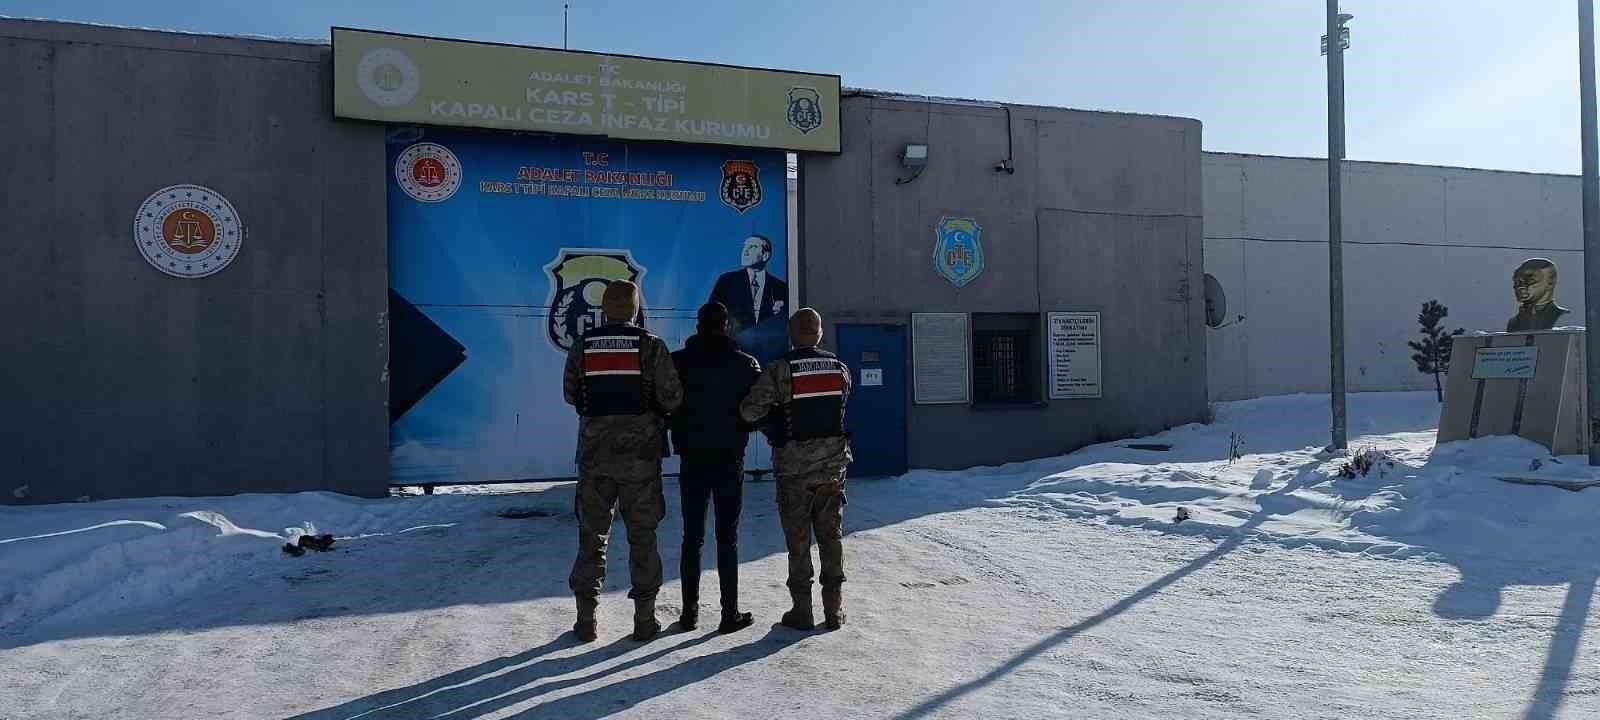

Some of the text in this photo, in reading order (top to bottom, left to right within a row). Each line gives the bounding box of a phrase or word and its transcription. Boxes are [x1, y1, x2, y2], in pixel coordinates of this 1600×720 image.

[528, 71, 687, 94] ADALET BAKANLIĞI
[526, 87, 593, 106] KARS
[601, 94, 617, 113] T
[642, 97, 686, 114] TİPİ
[431, 100, 771, 140] KAPALI CEZA İNFAZ KURUMU
[480, 180, 513, 194] KARS
[518, 166, 673, 187] ADALET BAKANLIĞI
